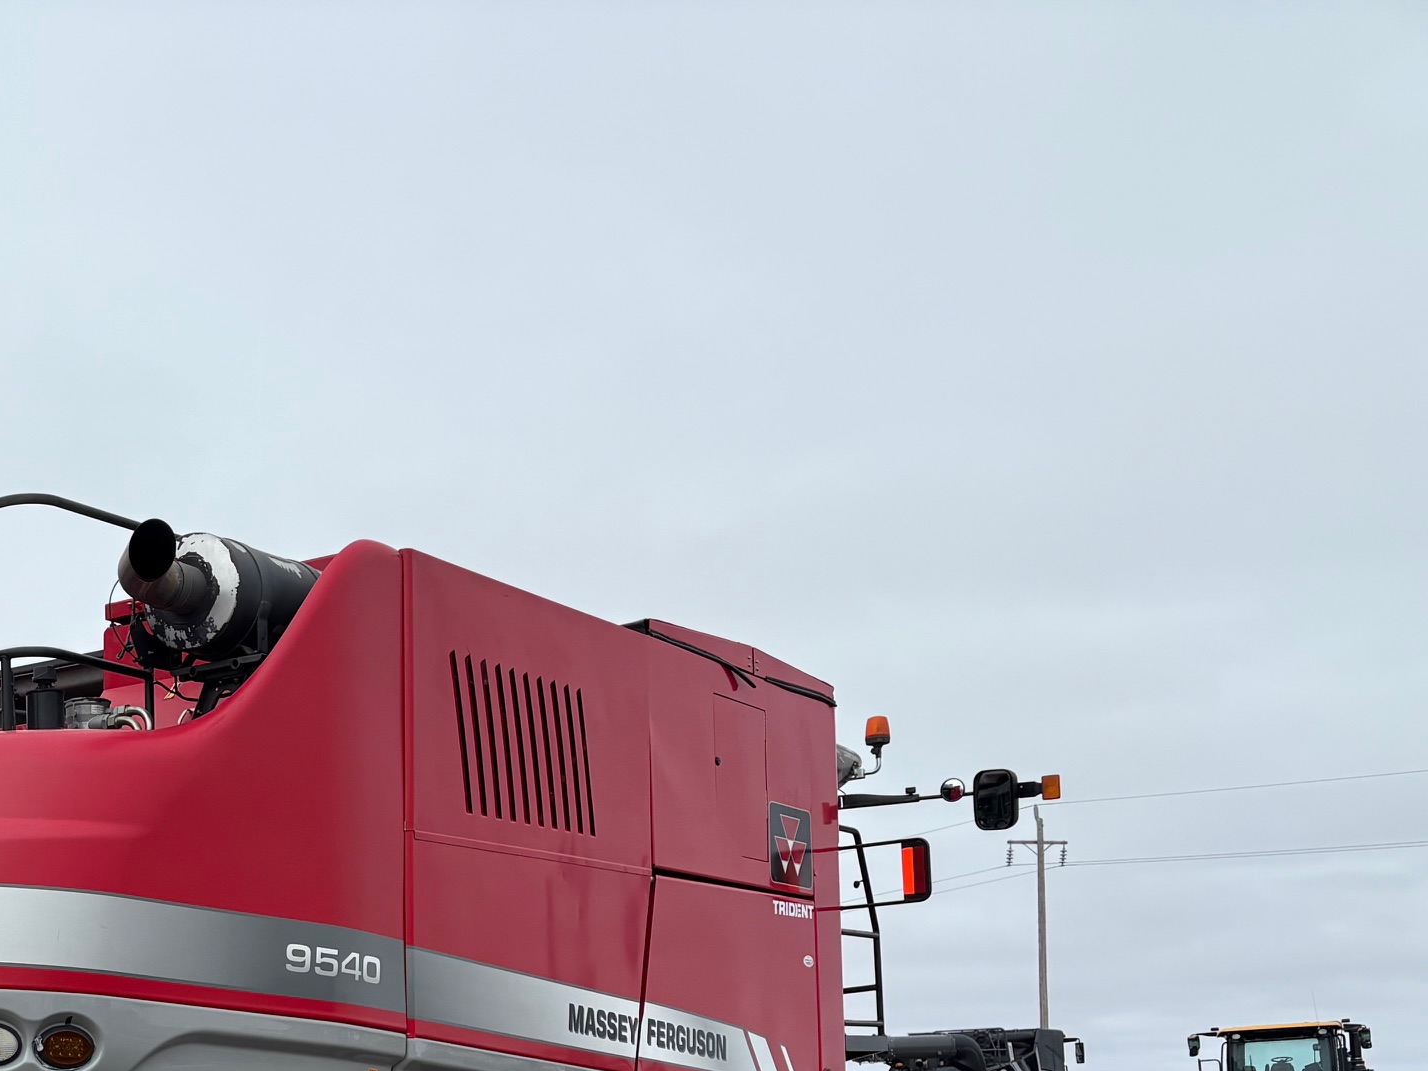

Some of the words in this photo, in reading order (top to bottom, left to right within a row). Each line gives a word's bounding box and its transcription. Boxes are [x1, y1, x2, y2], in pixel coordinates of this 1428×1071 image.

[772, 899, 814, 919] TRIDENT
[285, 943, 381, 984] 9540
[568, 1002, 639, 1045] MASSEY
[646, 1017, 727, 1062] FERGUSON
